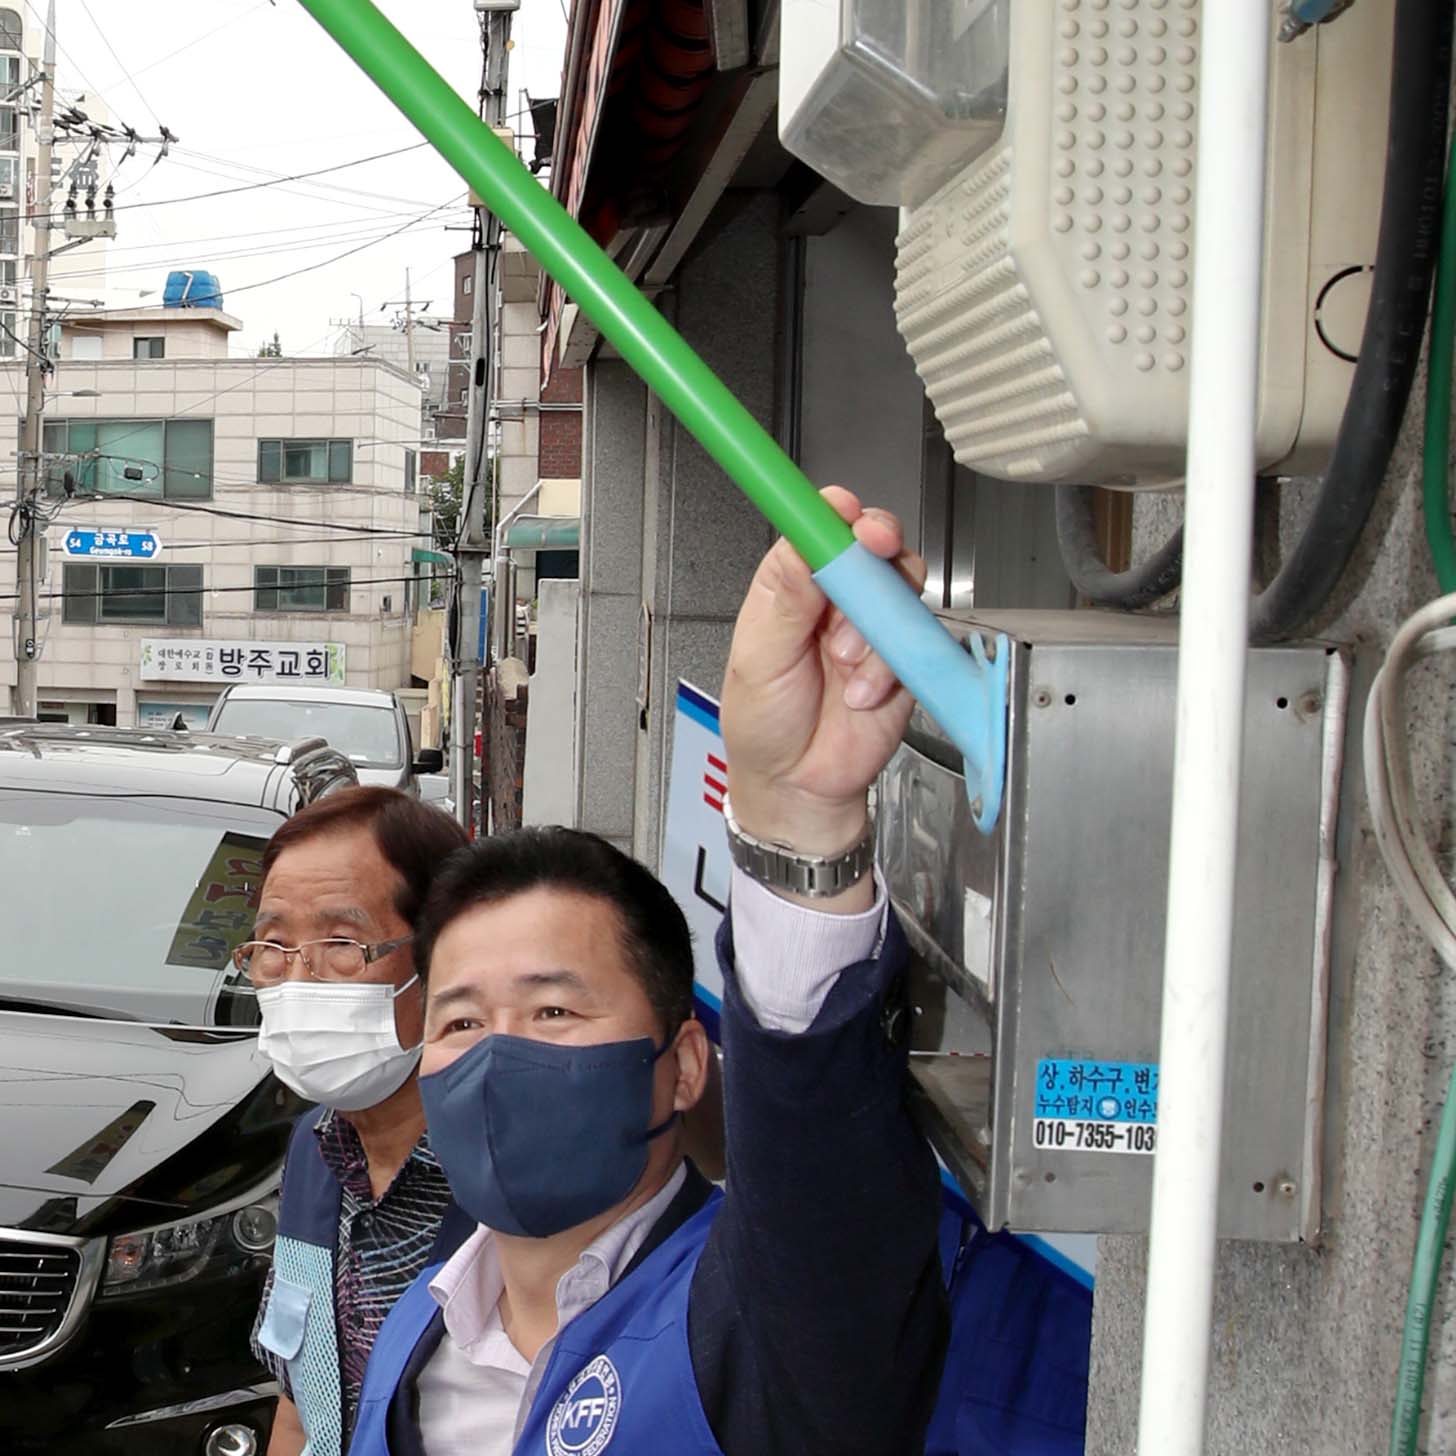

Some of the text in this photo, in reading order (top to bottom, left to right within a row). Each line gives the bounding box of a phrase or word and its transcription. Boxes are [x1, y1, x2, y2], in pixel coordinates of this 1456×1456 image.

[69, 538, 81, 548] 54
[94, 533, 129, 546] 금곡로
[141, 541, 154, 551] 58
[219, 648, 331, 678] 방주교회
[1038, 1095, 1157, 1121] 누수탐지 언수
[1035, 1120, 1156, 1152] 010-7355-103
[560, 1397, 605, 1430] KFF
